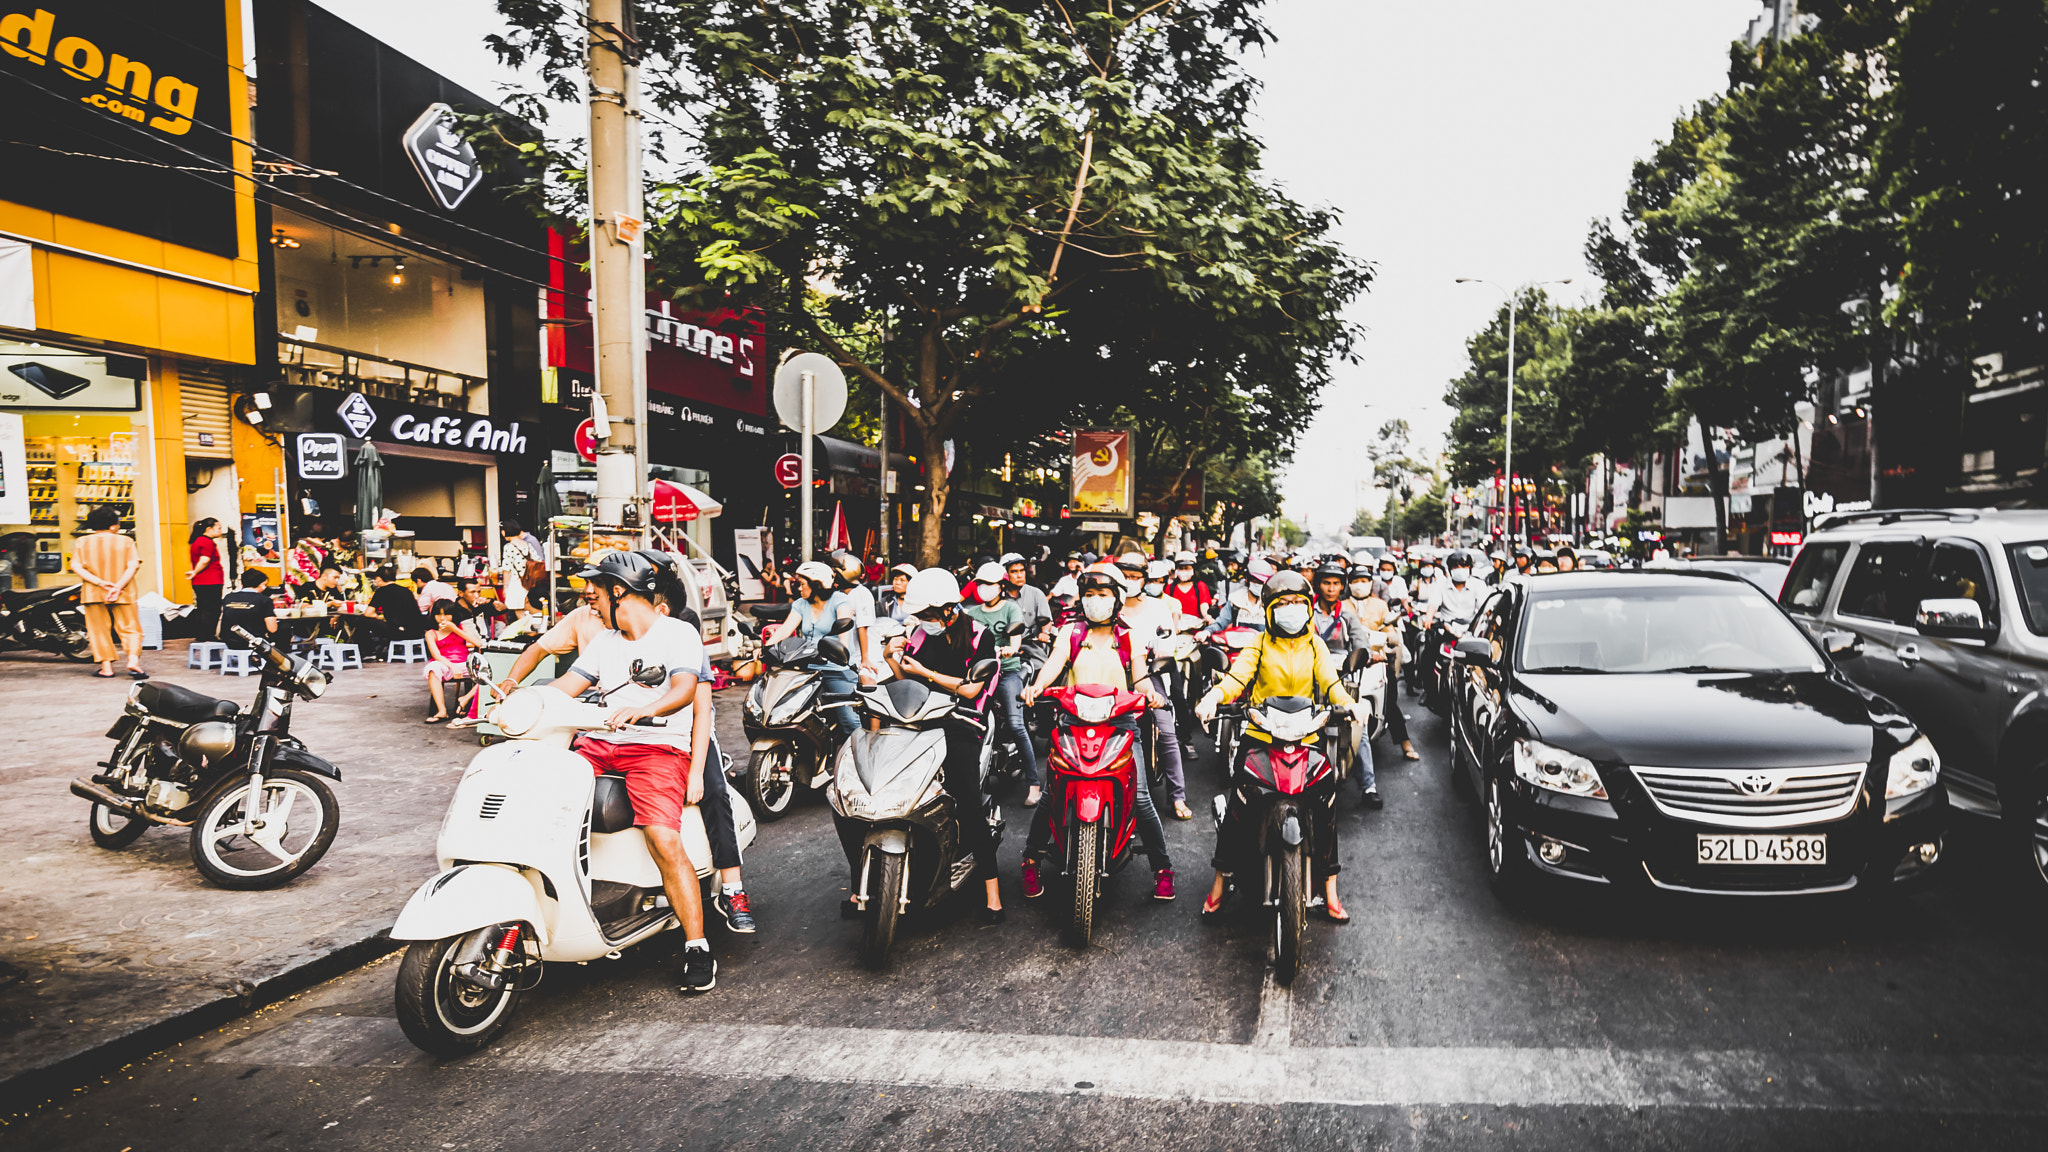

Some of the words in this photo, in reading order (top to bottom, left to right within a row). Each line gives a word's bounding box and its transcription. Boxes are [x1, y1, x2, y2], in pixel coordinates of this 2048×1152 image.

[80, 93, 145, 123] .com
[390, 414, 462, 446] Café
[464, 419, 527, 455] Anh
[303, 439, 337, 457] Open
[304, 460, 340, 472] 24/24
[1699, 838, 1826, 862] 52LD-4589
